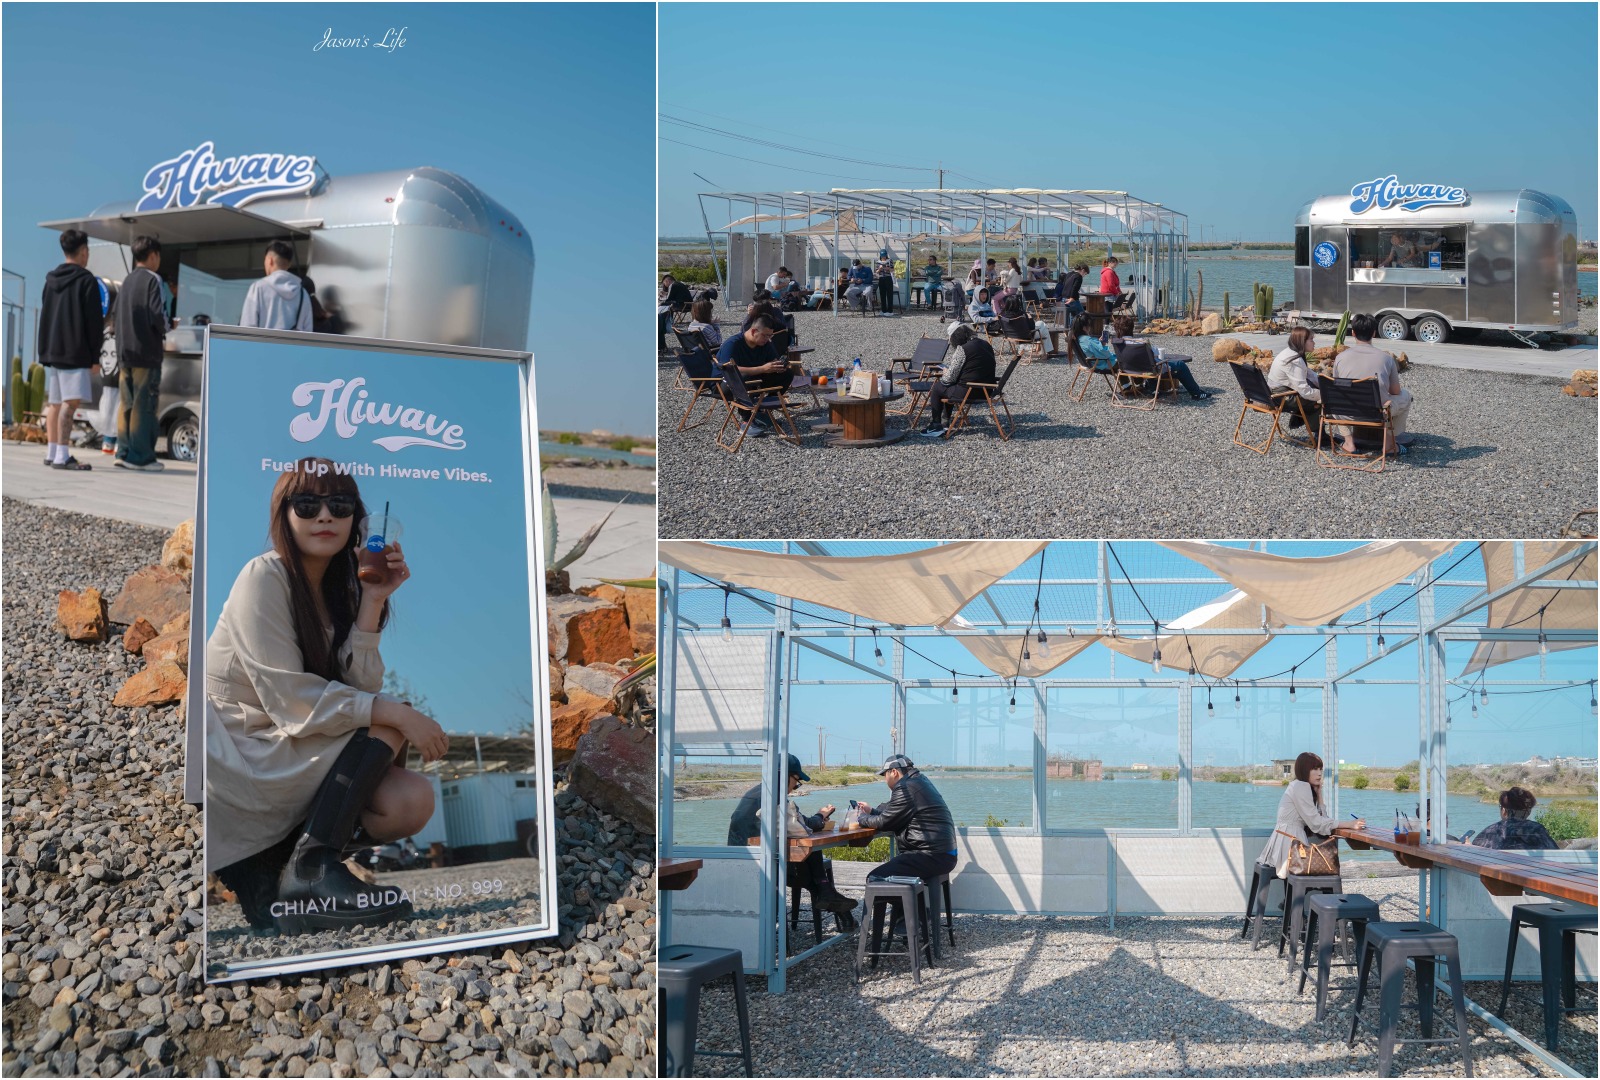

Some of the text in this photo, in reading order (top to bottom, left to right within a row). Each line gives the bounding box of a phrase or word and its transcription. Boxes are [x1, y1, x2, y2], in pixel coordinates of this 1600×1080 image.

[136, 140, 316, 211] Hiwave
[1350, 174, 1468, 215] Hiwave
[290, 377, 466, 452] Hiwave
[261, 457, 493, 484] Fuel Up With Hiwave Vibes.
[270, 896, 336, 918] CHIAYI
[356, 888, 416, 909] BUDAI
[472, 879, 503, 896] 999
